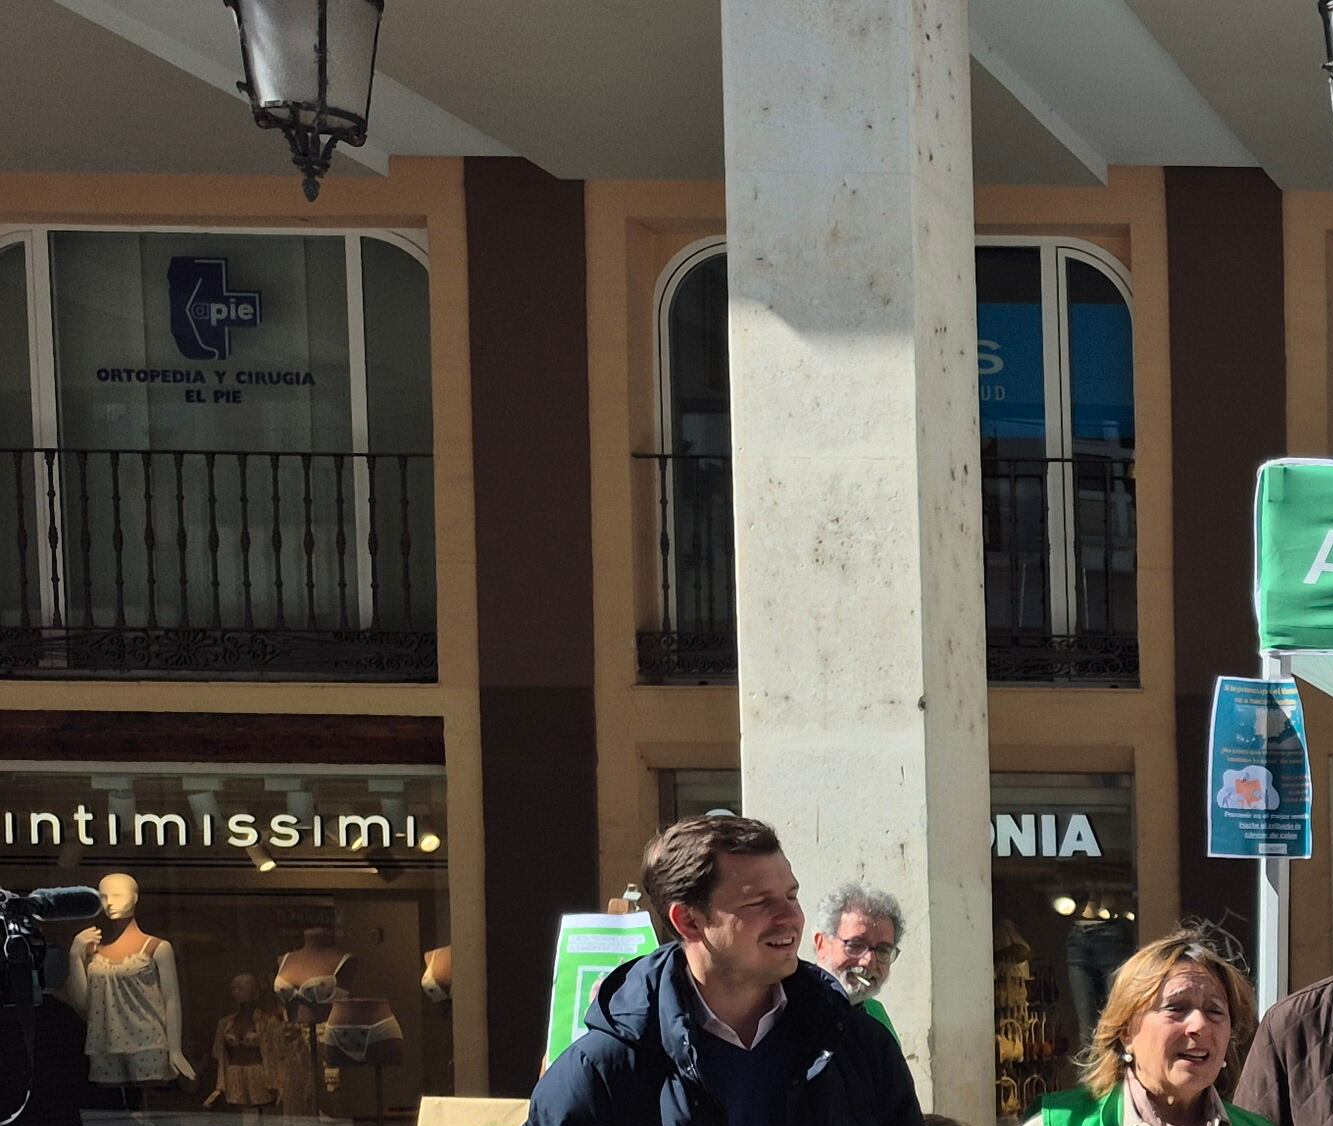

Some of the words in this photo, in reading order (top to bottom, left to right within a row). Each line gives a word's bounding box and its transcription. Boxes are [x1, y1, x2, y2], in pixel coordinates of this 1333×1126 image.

[96, 368, 206, 384] ORTOPEDIA
[214, 371, 227, 384] Y
[235, 371, 316, 386] CIRUGIA
[184, 389, 206, 404] EL
[213, 390, 242, 404] PIE
[4, 804, 415, 848] intimissimi
